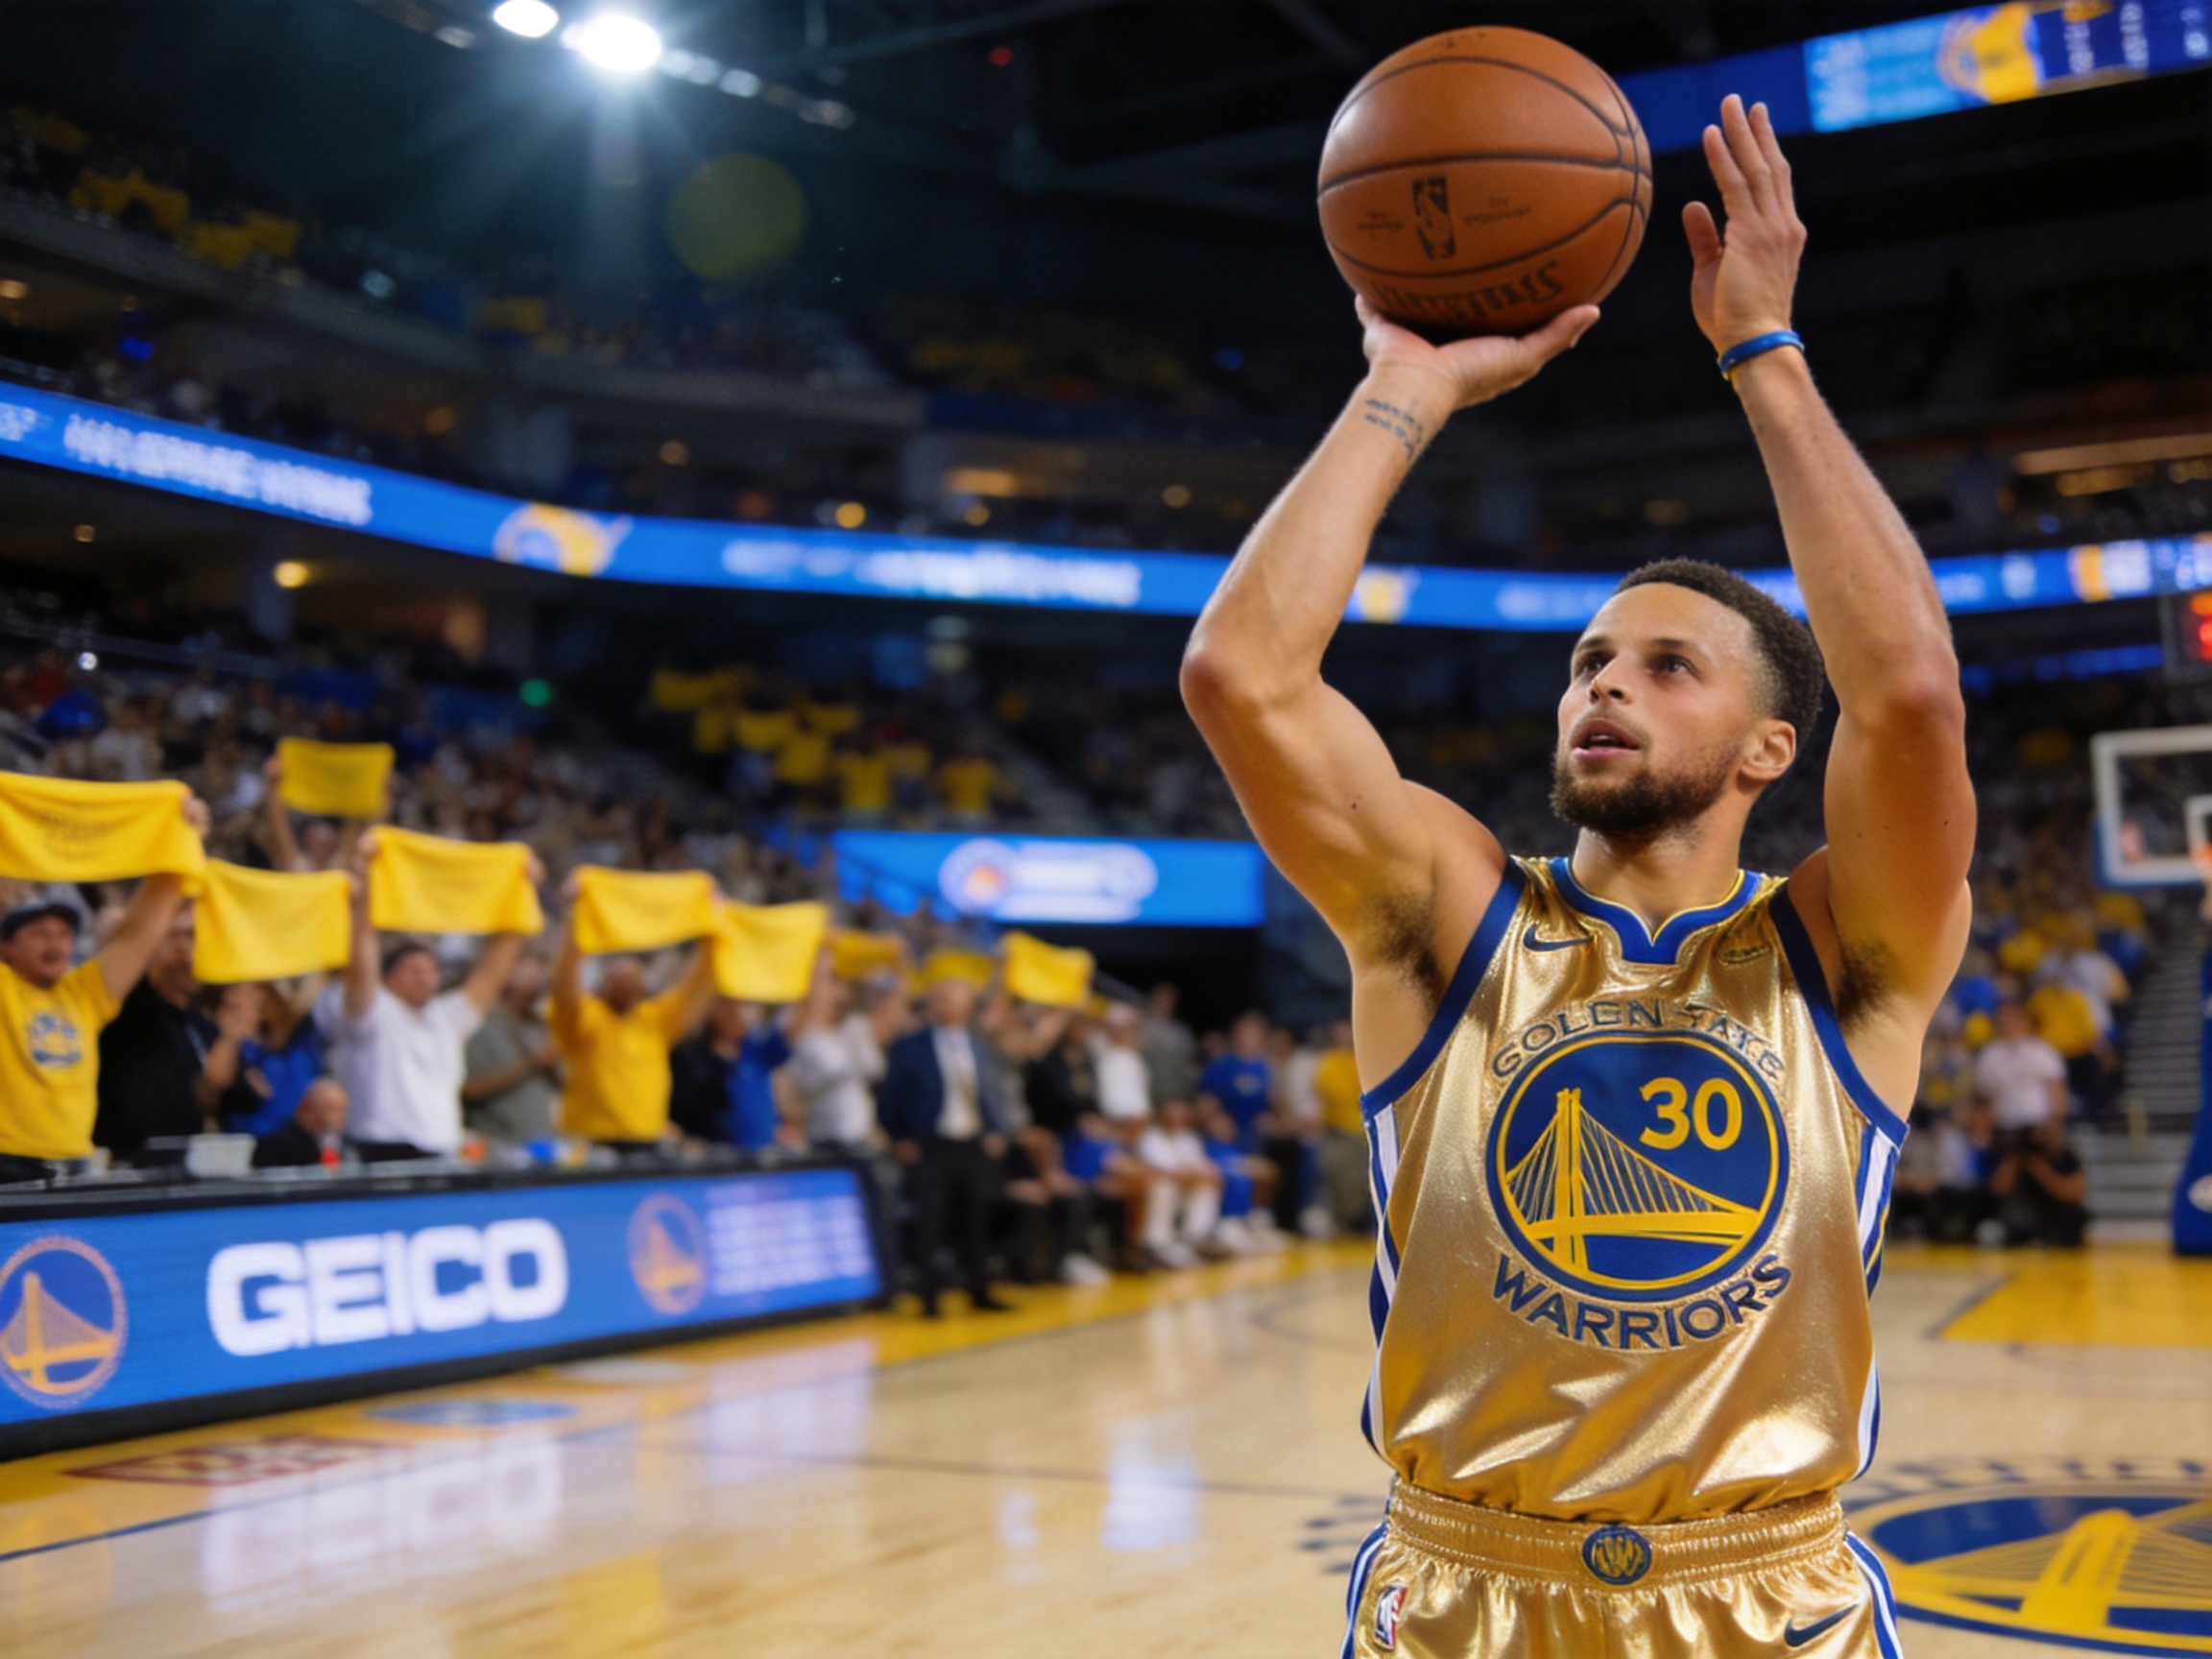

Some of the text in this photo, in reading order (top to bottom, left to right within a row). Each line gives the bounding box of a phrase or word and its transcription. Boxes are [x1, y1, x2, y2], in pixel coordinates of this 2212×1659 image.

[1639, 1076, 1743, 1151] 30
[205, 1216, 569, 1358] GEICO
[1493, 1253, 1792, 1350] WARRIORS
